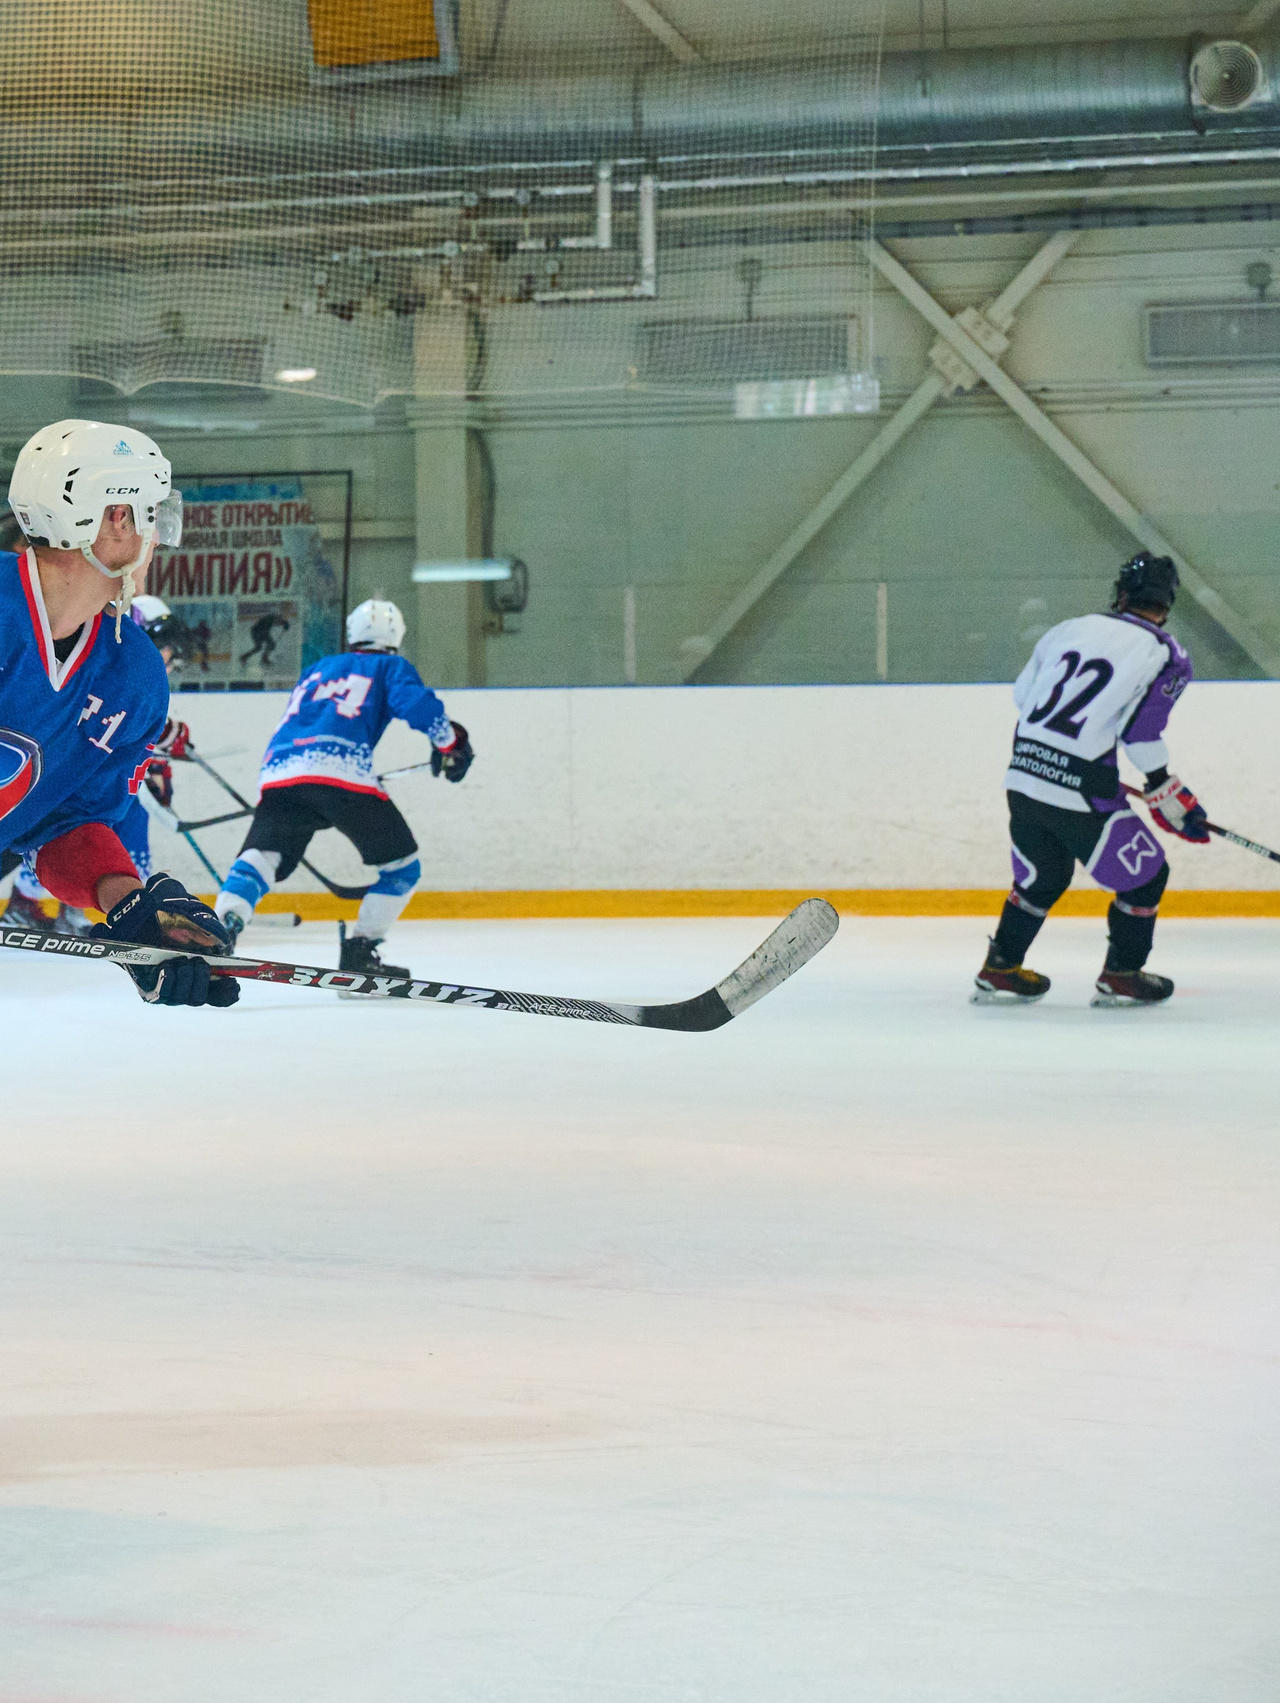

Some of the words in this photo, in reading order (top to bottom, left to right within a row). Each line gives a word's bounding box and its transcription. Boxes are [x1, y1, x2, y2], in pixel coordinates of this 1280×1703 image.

[106, 487, 140, 495] CCM
[1026, 650, 1114, 740] 32
[77, 693, 127, 754] 71
[113, 893, 141, 922] CCM
[41, 937, 106, 956] prime
[288, 967, 497, 1008] SOYUZ
[529, 1002, 556, 1013] ACE
[557, 1005, 591, 1018] prime
